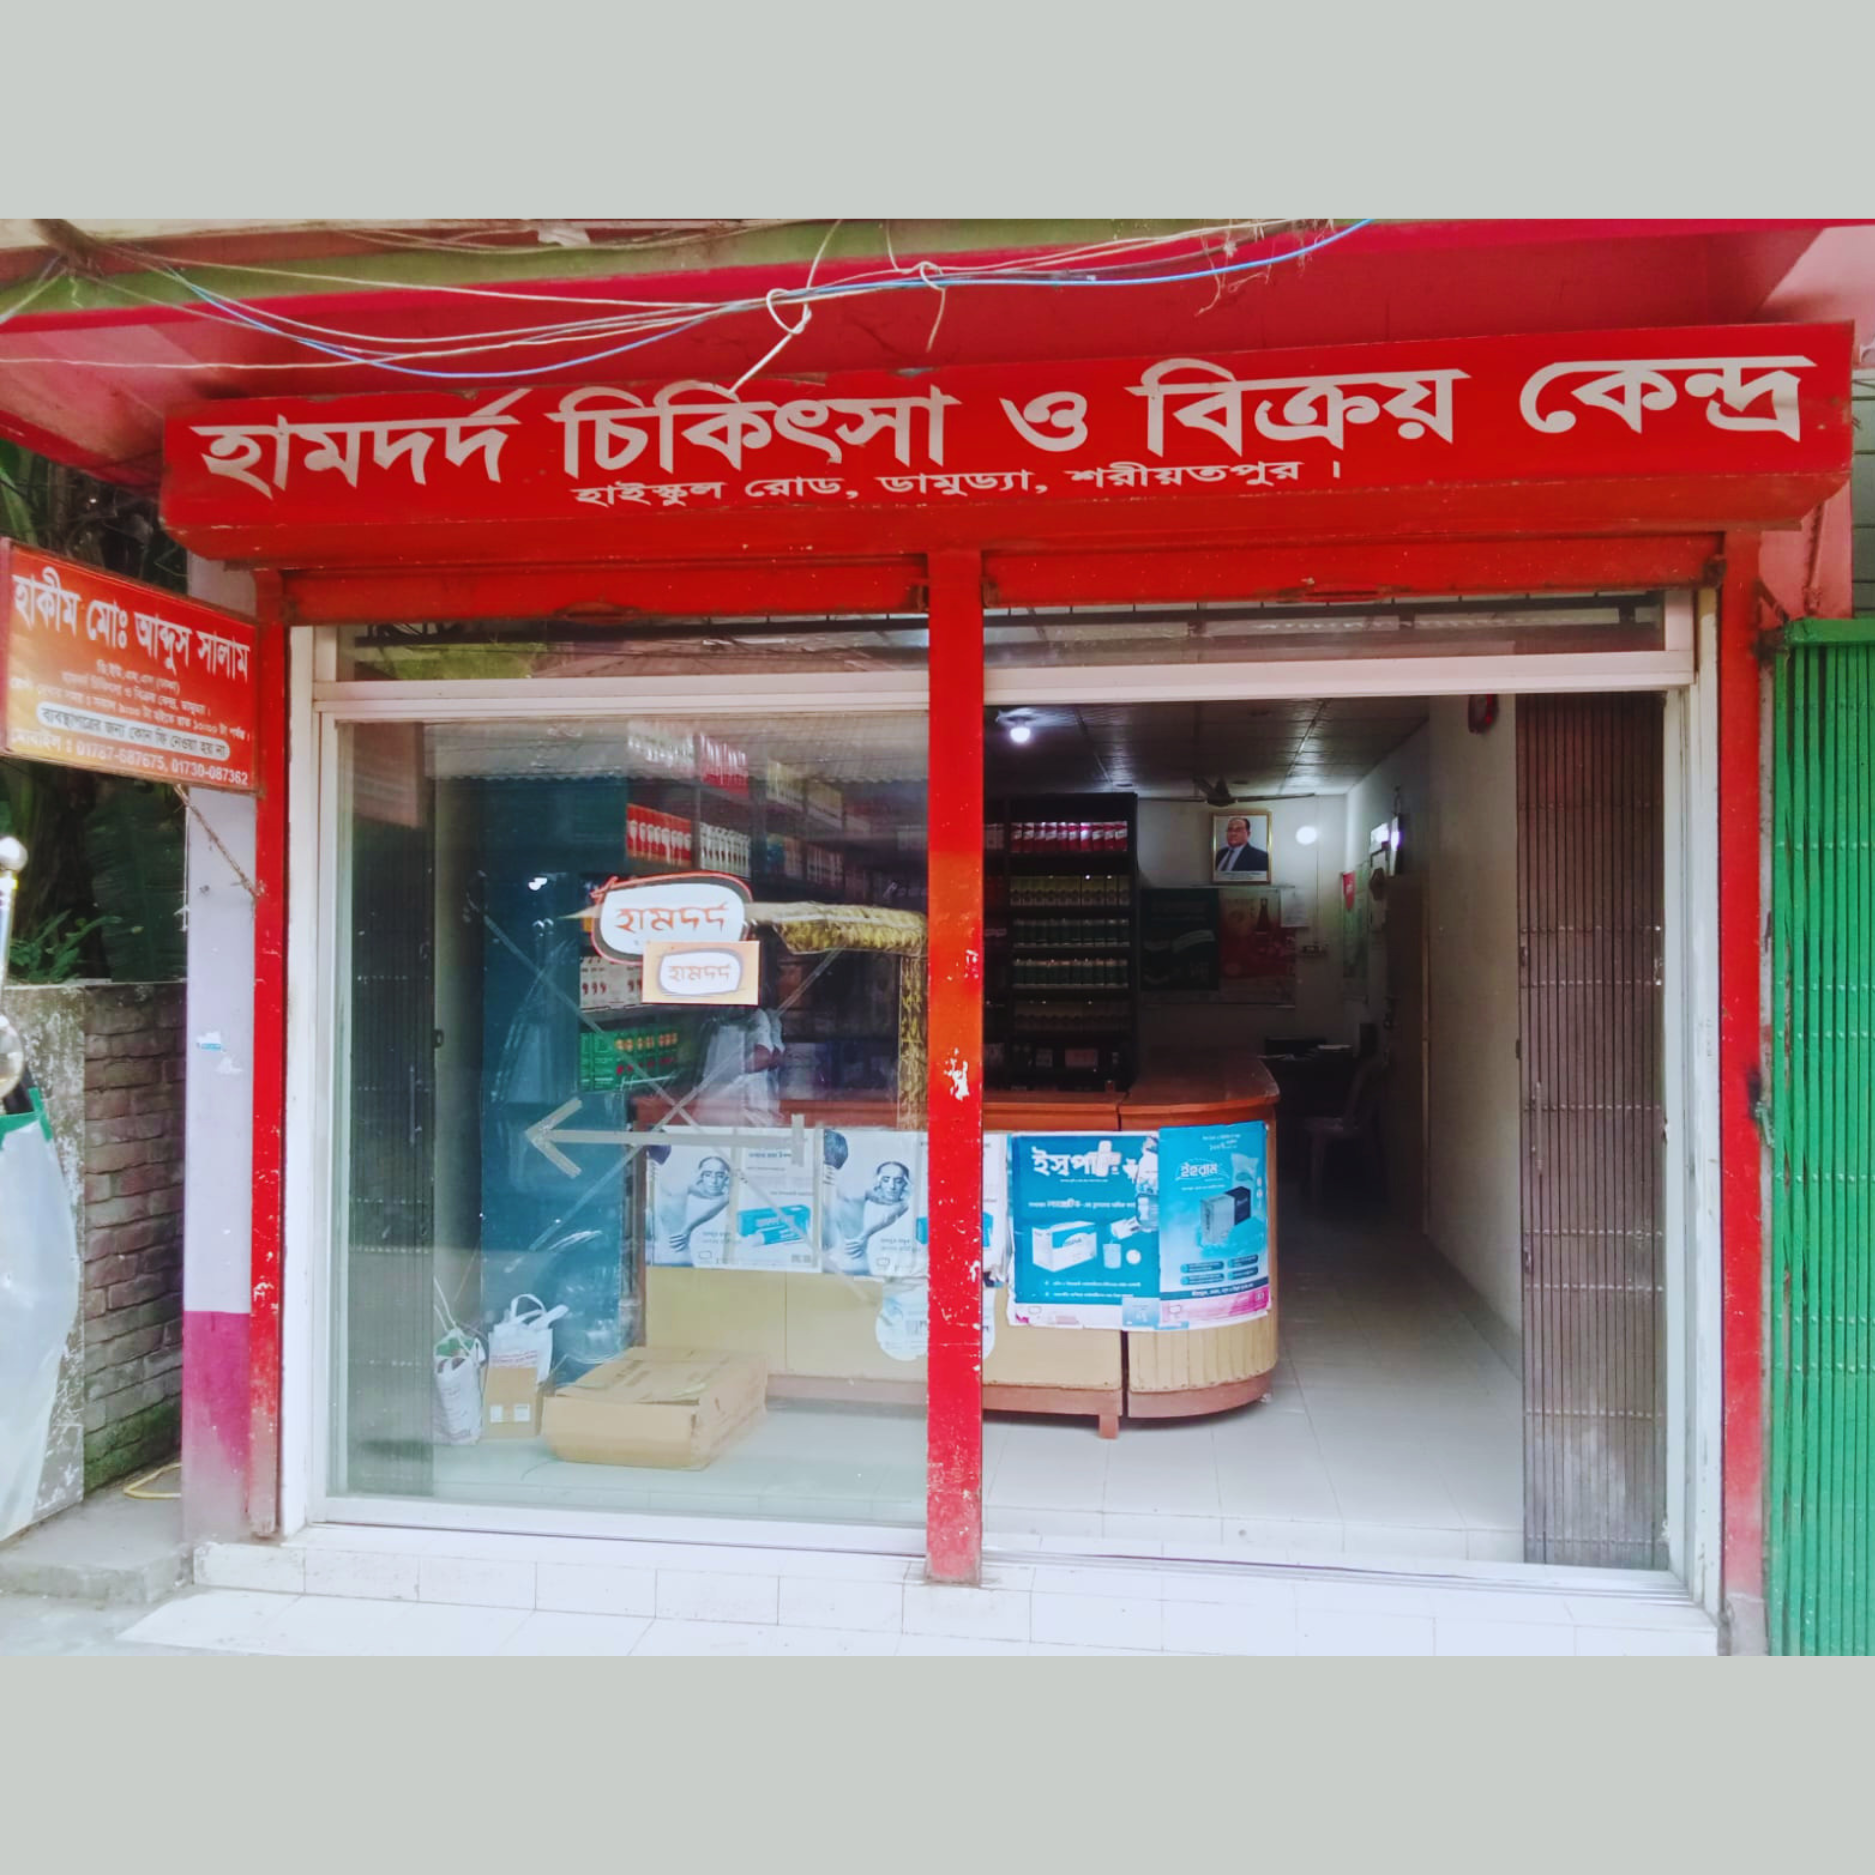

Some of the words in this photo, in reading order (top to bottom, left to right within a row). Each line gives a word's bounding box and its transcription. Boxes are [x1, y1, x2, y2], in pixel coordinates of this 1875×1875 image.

[191, 388, 532, 498] হামদর্দ
[546, 380, 961, 480] চিকিৎসা
[999, 391, 1088, 452] ও
[1125, 358, 1471, 457] বিক্রয়
[1519, 356, 1817, 441] কেন্দ্র
[572, 481, 727, 507] হাইস্কুল
[745, 476, 858, 499] রোড,
[876, 469, 1048, 495] ডামুড্যা,
[1064, 461, 1304, 488] শরীয়তপুর
[12, 566, 81, 636] হাকীম
[86, 599, 128, 650] মোঃ
[134, 611, 192, 675] আব্দুস
[197, 631, 250, 683] সালাম
[615, 901, 729, 933] হামদর্দ
[668, 964, 732, 982] হামদর্দ
